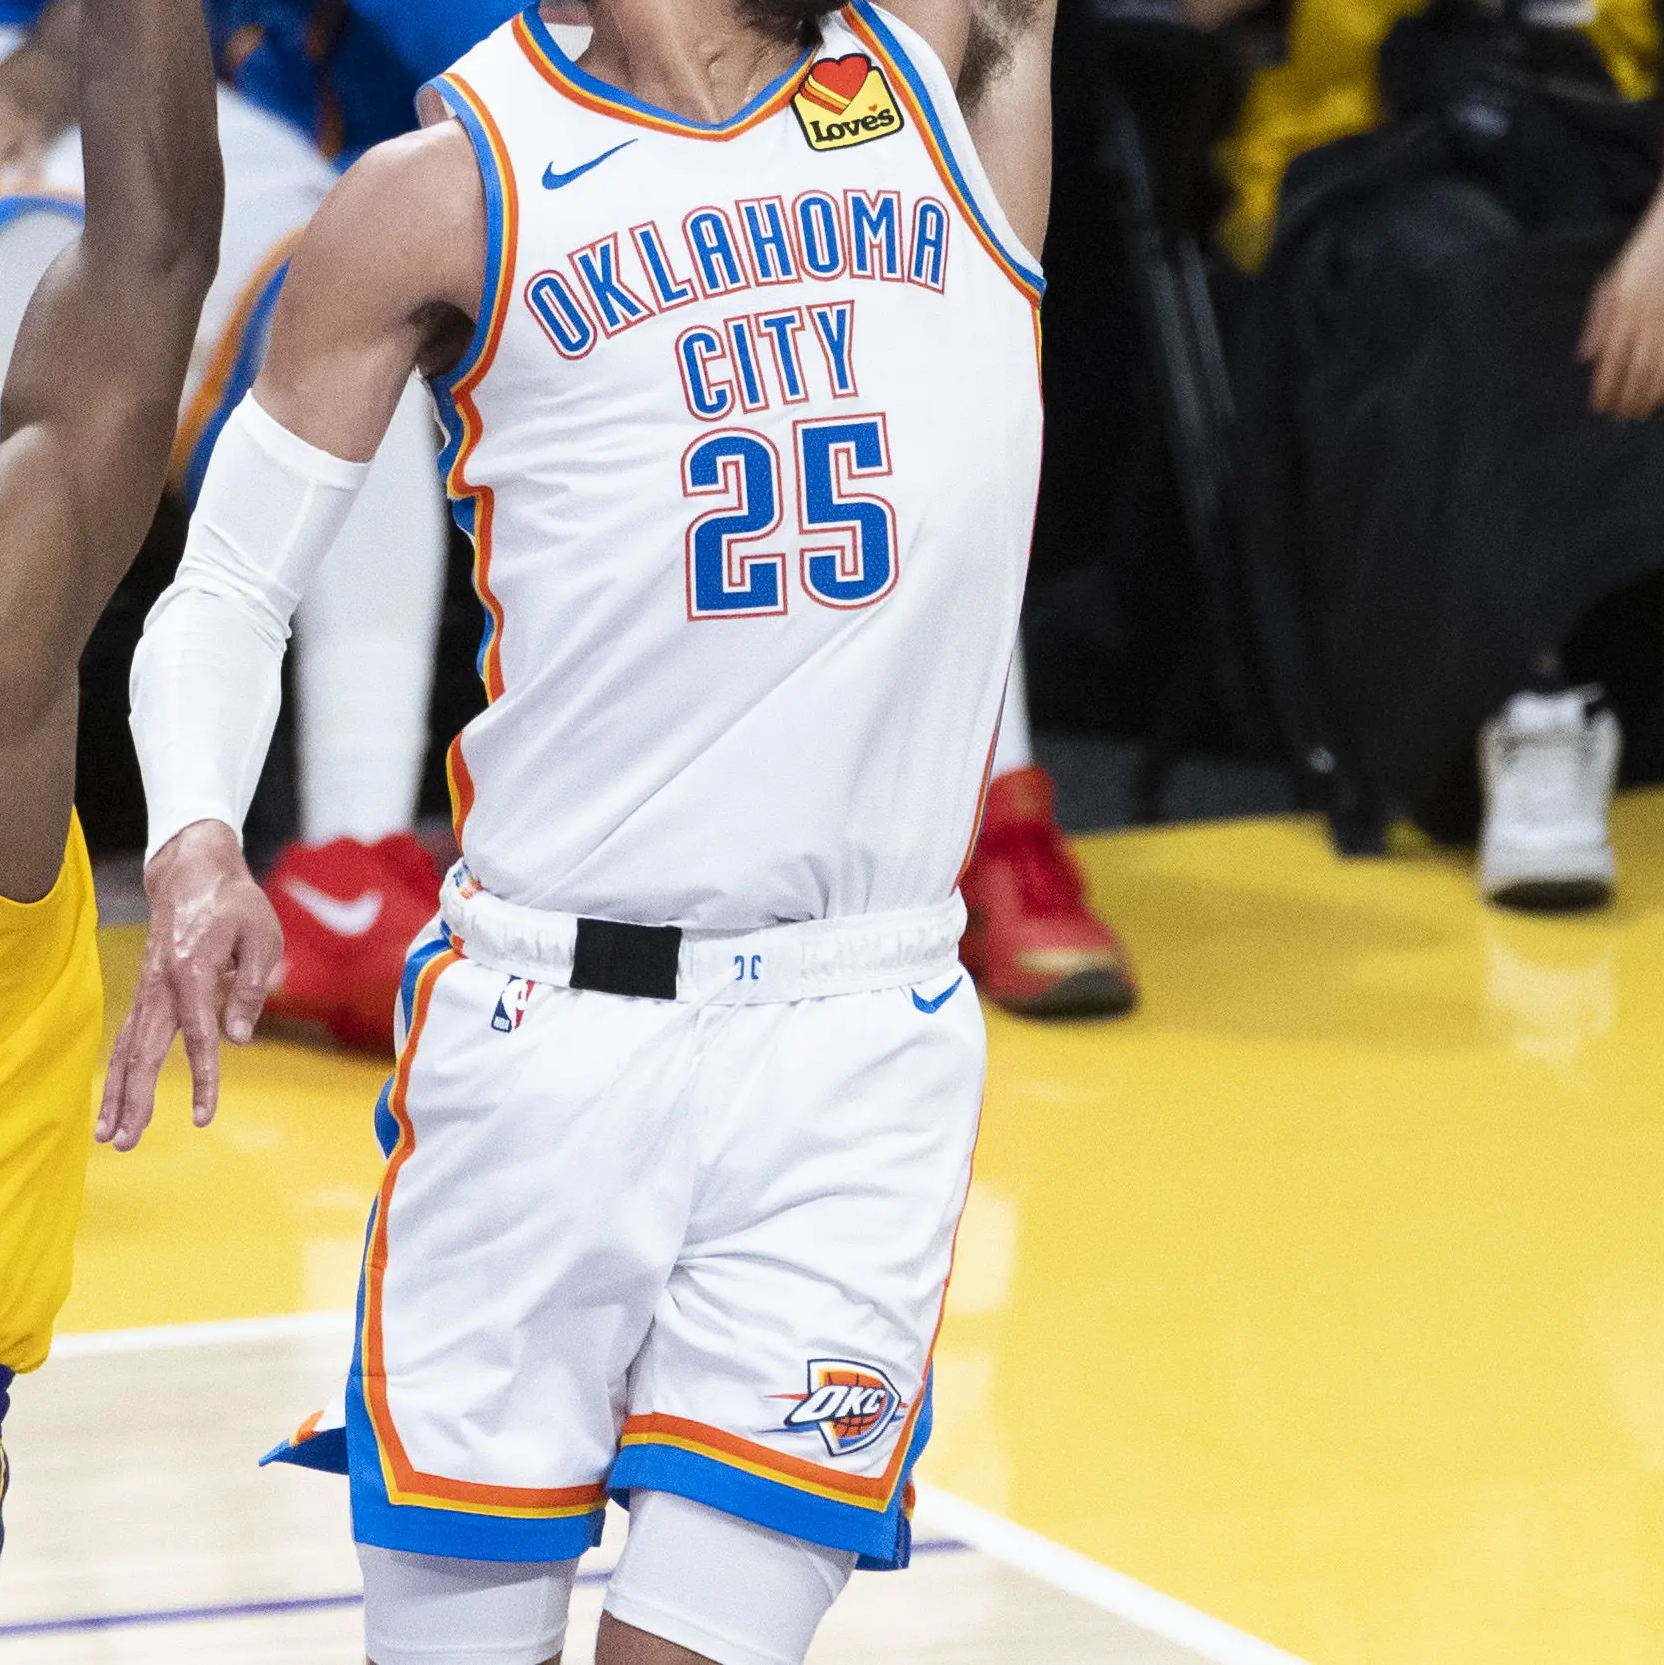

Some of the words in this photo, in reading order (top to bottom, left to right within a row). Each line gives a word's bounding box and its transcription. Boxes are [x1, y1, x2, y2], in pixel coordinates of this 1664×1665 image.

[524, 188, 951, 361] OKLAHOMA
[674, 299, 858, 423] CITY
[680, 412, 900, 622] 25
[789, 1383, 888, 1424] OKC
